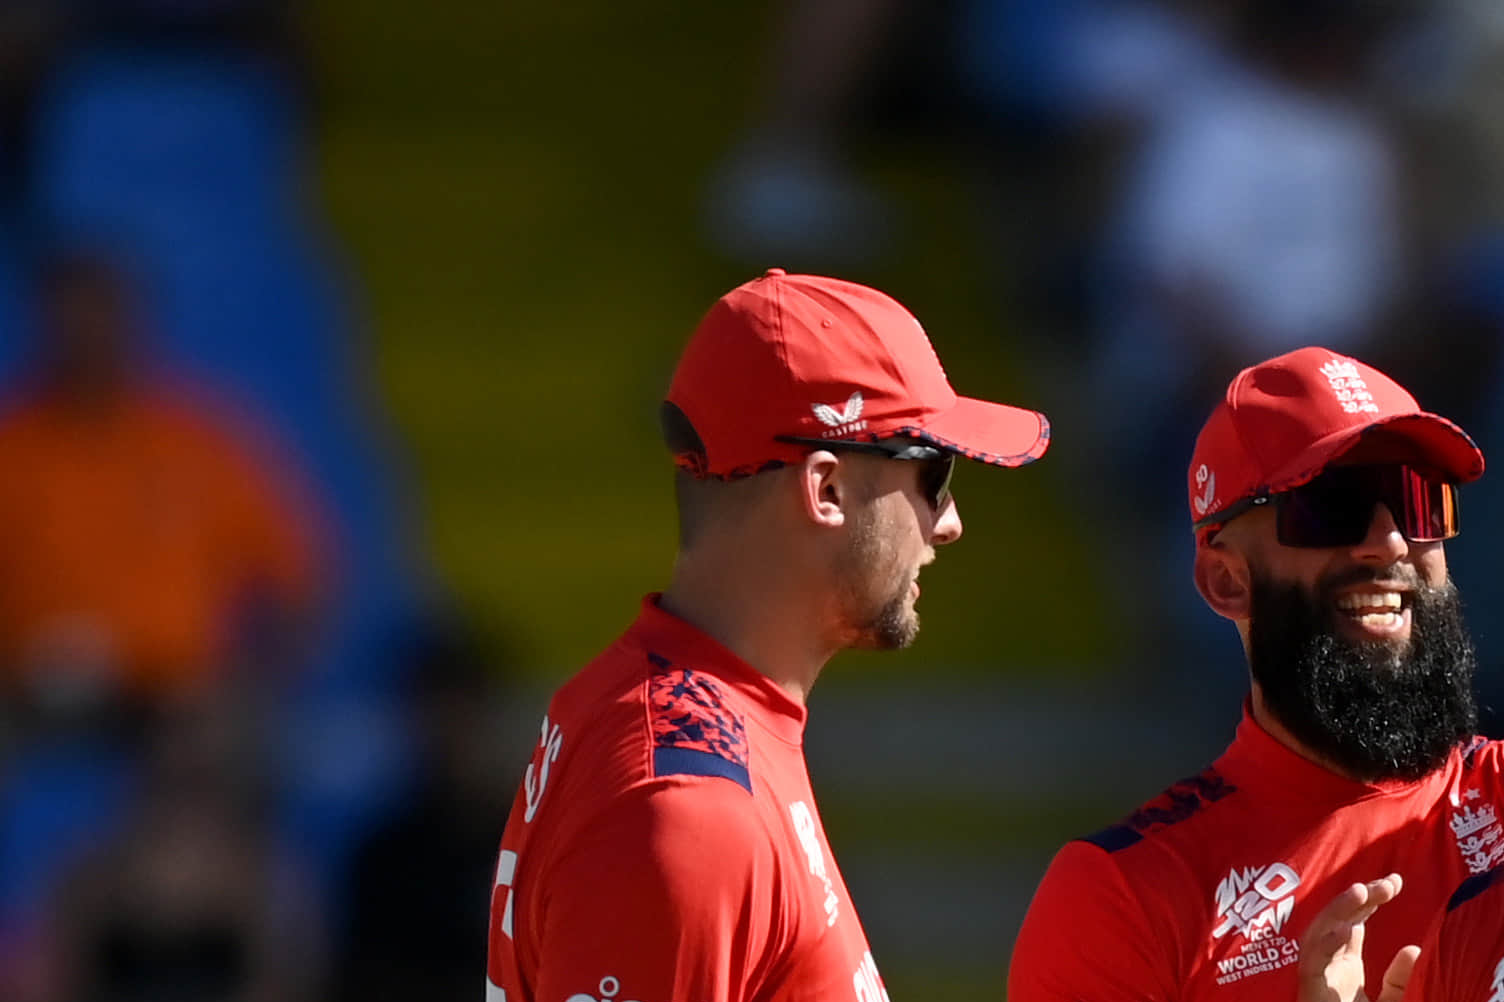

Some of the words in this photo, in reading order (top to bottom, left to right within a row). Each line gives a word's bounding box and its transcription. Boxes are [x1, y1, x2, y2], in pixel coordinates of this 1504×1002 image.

[1250, 926, 1273, 942] ICC
[1217, 948, 1280, 974] WORLD
[1216, 971, 1242, 986] WEST
